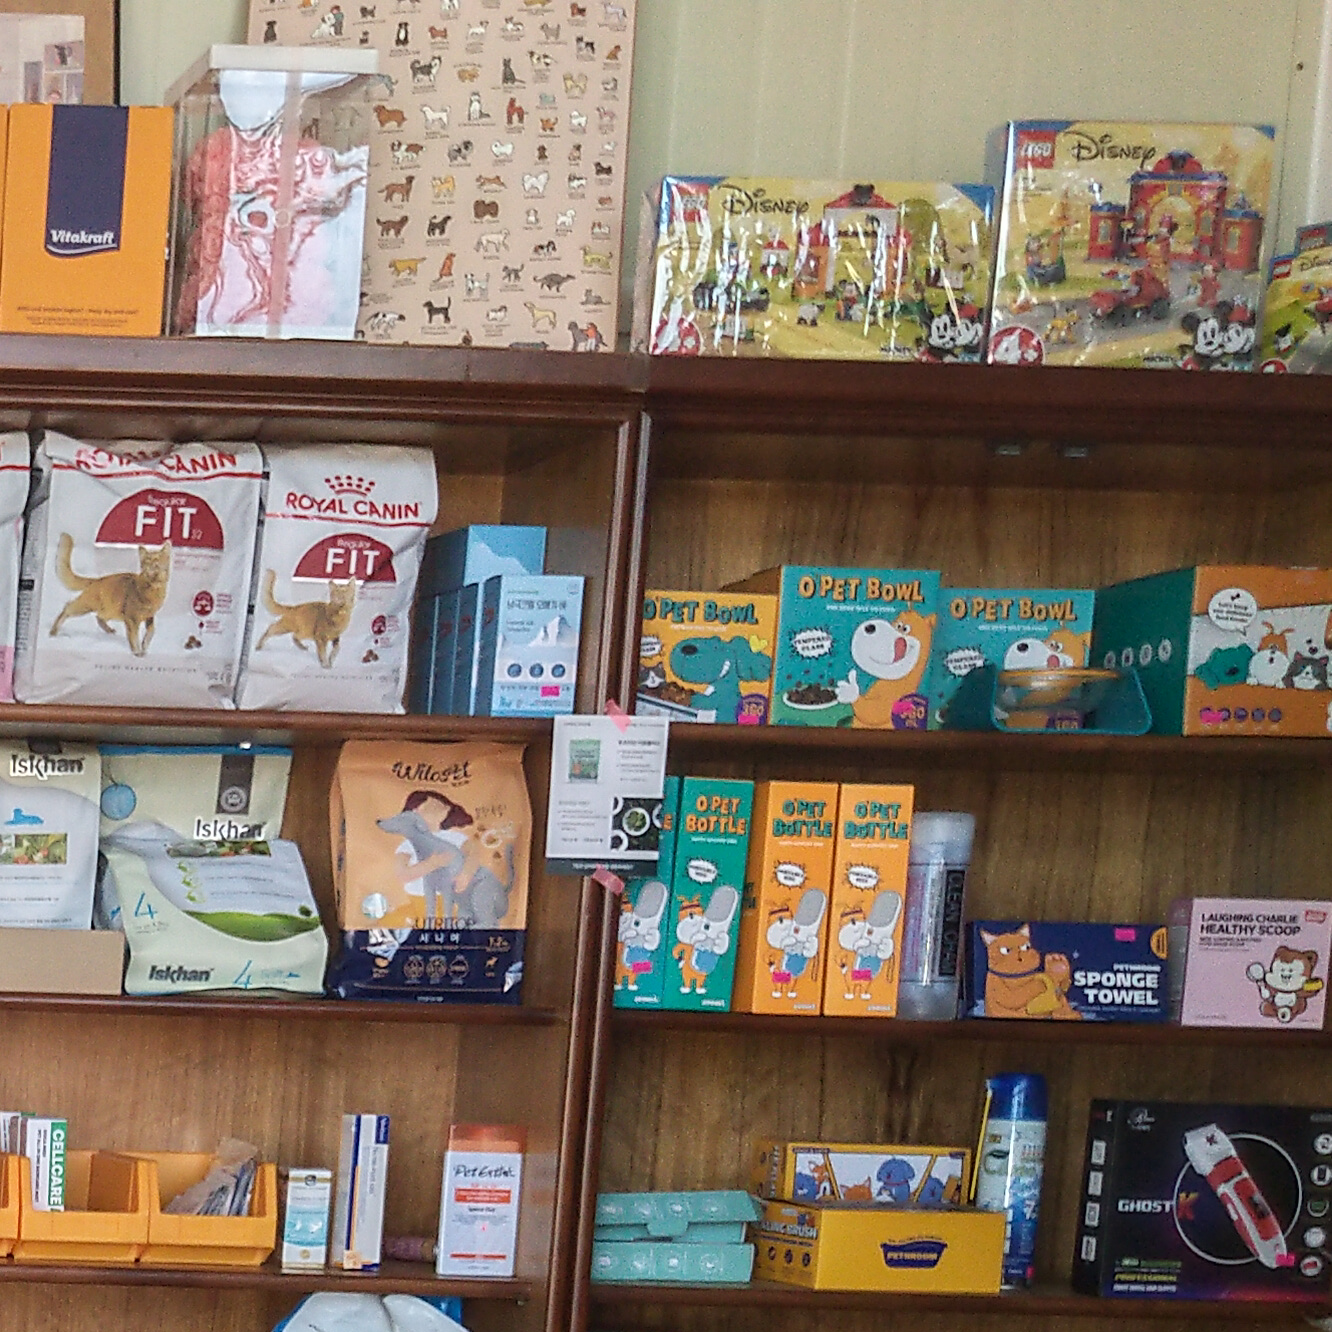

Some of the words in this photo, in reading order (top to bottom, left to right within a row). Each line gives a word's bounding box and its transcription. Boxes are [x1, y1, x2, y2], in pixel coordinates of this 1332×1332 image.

[50, 229, 115, 245] Vitakraft
[286, 492, 348, 514] ROYAL
[354, 500, 419, 520] CANIN
[135, 504, 197, 539] FIT
[325, 548, 380, 576] FIT
[11, 754, 84, 778] Iskhan
[195, 818, 266, 839] Iskhan
[686, 813, 747, 835] BOTTLE
[772, 818, 833, 838] BOTTLE
[844, 820, 908, 839] BOTTLE
[1200, 924, 1257, 936] HEALTHY
[1258, 926, 1301, 936] SCOOP
[149, 964, 214, 983] Iskhan
[1073, 971, 1159, 989] SPONGE
[1084, 988, 1159, 1006] TOWEL
[48, 1129, 66, 1206] CELLCARE
[1117, 1198, 1174, 1213] GHOST
